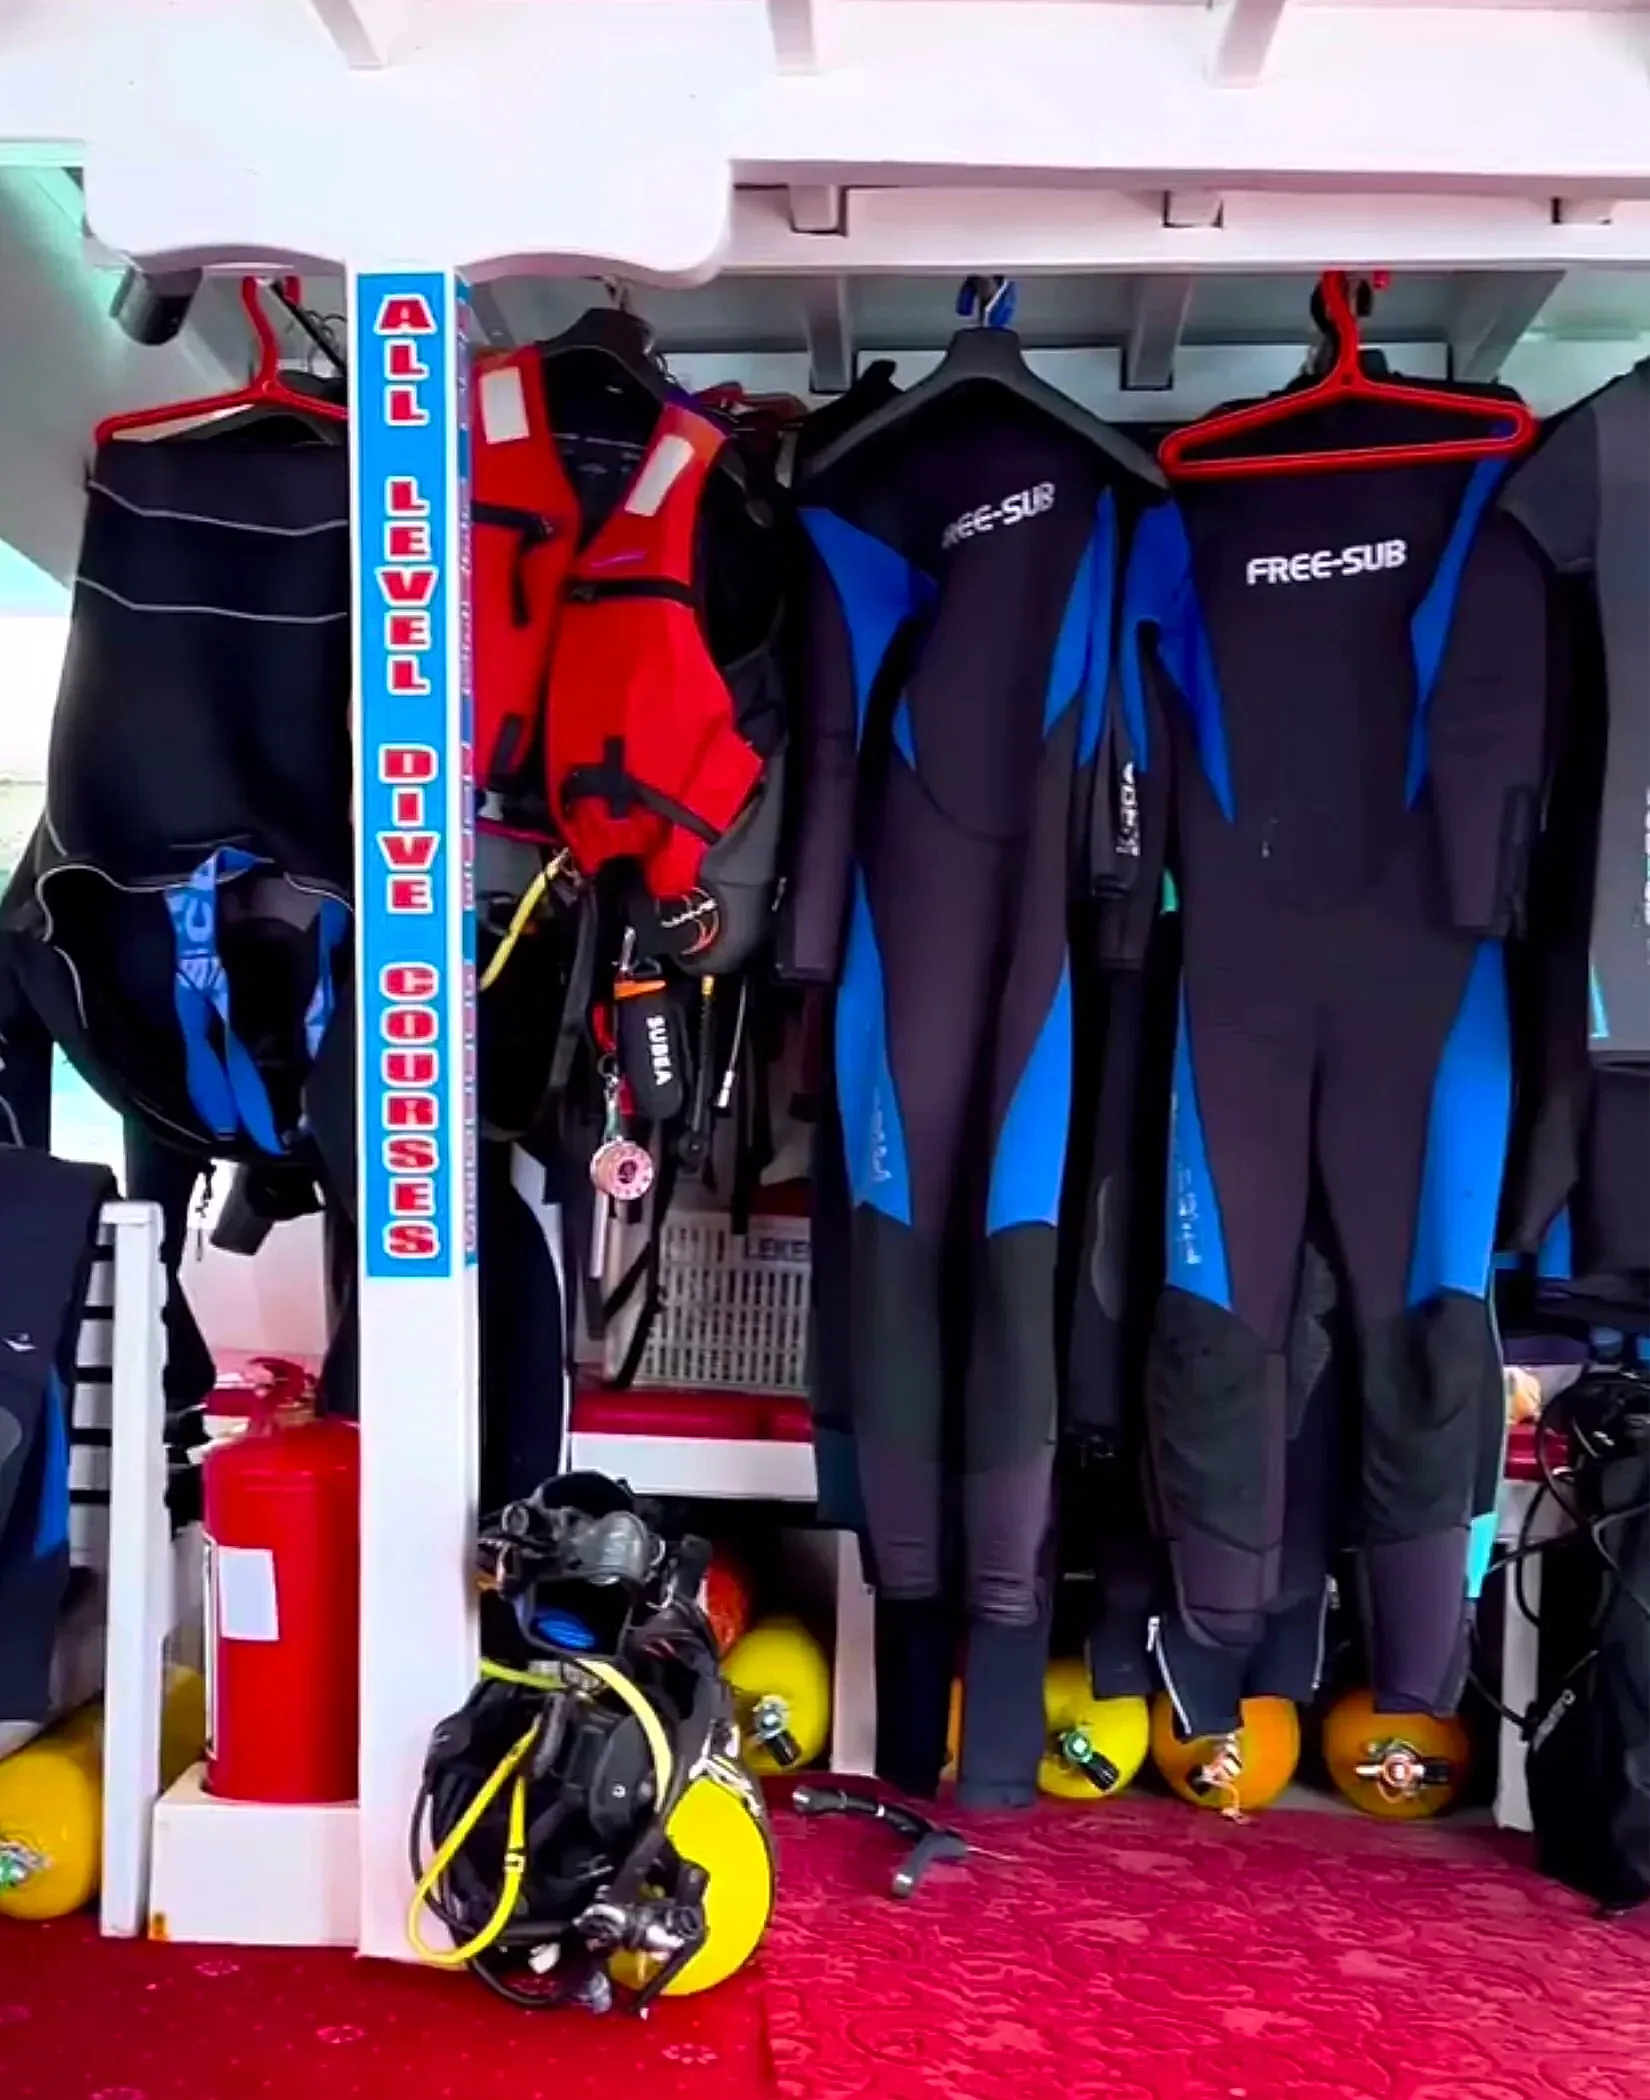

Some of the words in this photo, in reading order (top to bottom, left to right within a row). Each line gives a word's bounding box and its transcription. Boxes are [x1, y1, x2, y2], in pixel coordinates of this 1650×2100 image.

[373, 293, 437, 427] ALL
[375, 475, 439, 696] LEVEL
[941, 481, 1056, 549] REE-SUB
[1246, 539, 1406, 585] FREE-SUB
[376, 743, 440, 914] DIVE
[379, 961, 440, 1260] COURSES
